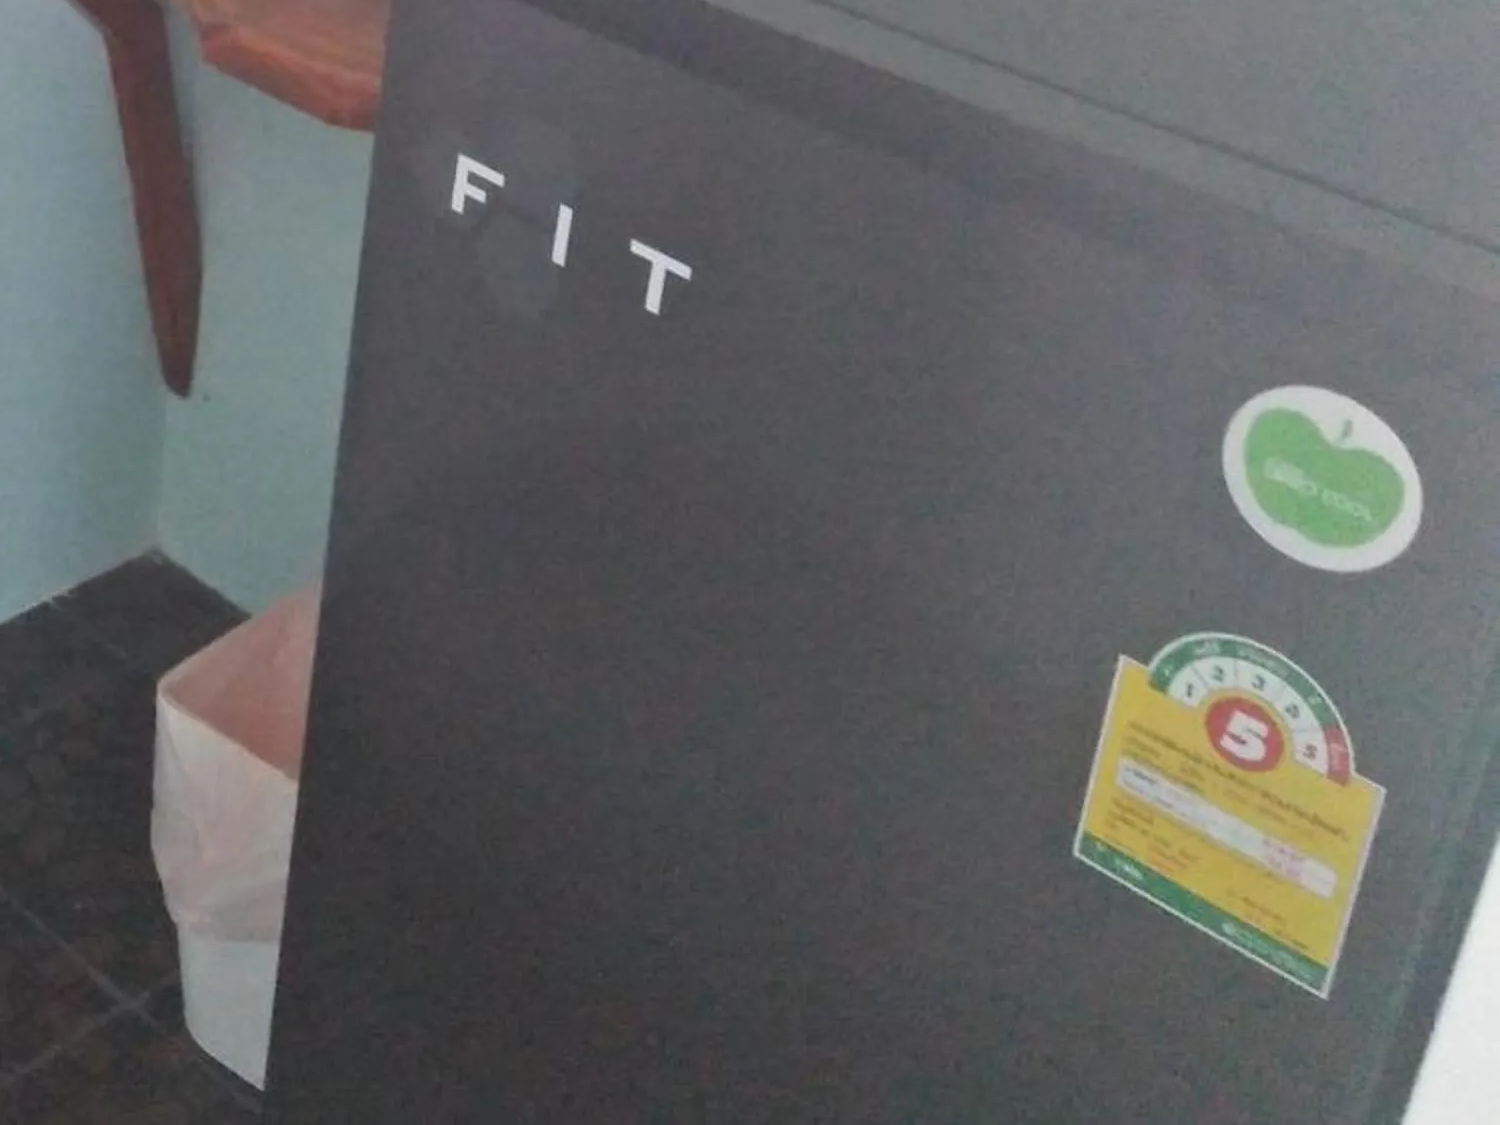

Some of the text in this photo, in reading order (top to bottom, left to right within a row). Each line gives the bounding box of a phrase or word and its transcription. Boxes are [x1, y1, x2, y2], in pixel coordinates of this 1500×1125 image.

[1211, 664, 1225, 682] 2
[1251, 674, 1266, 691] 3
[1220, 709, 1269, 762] 5
